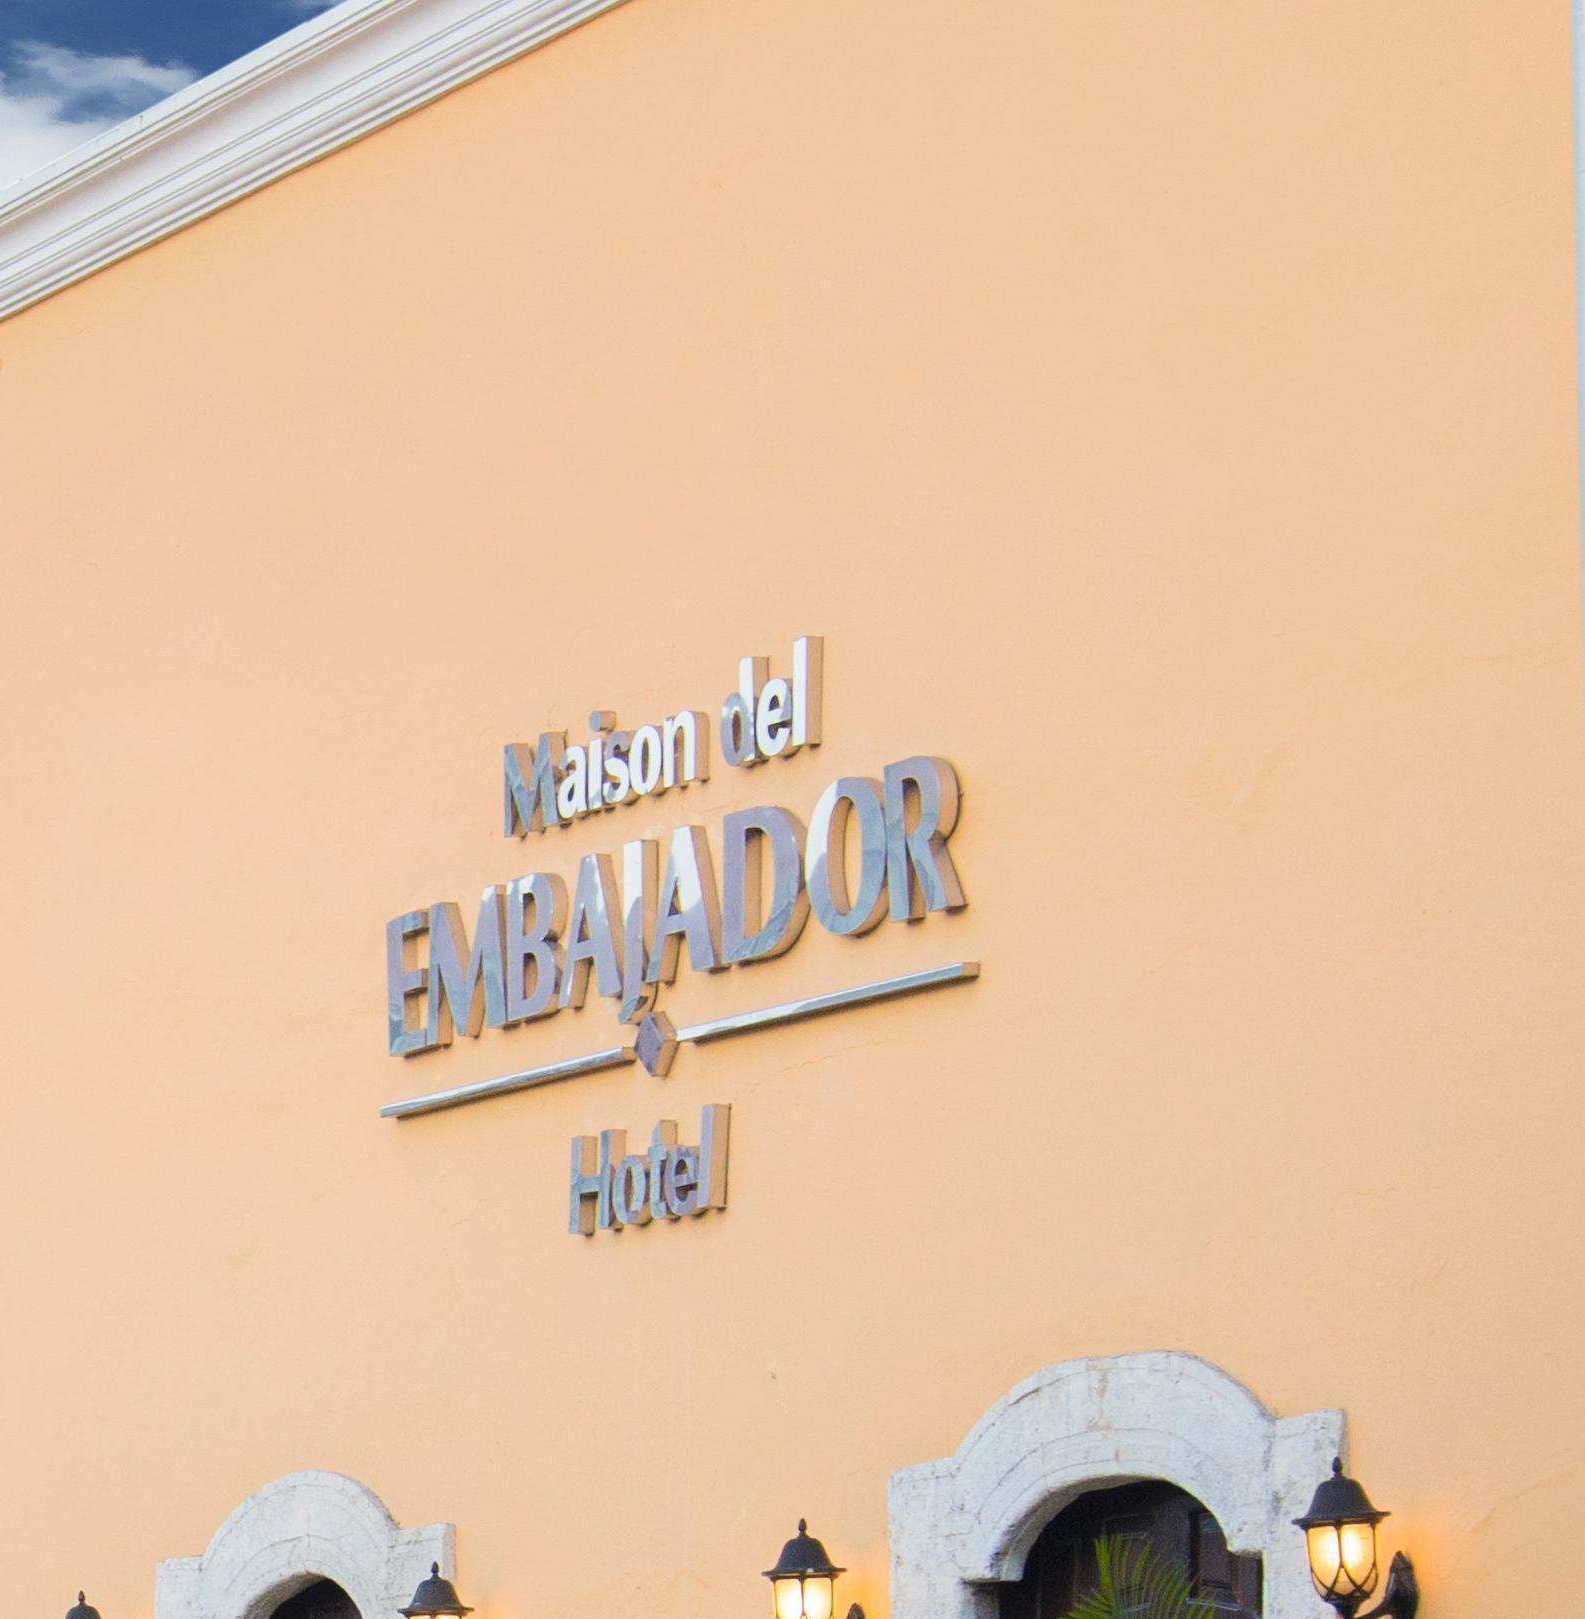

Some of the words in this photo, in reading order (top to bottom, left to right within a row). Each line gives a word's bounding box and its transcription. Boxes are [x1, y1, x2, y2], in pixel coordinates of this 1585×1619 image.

[504, 710, 709, 837] Maison
[721, 635, 825, 768] del
[386, 754, 968, 1057] EMBAJADOR
[568, 1103, 732, 1236] Hotel
